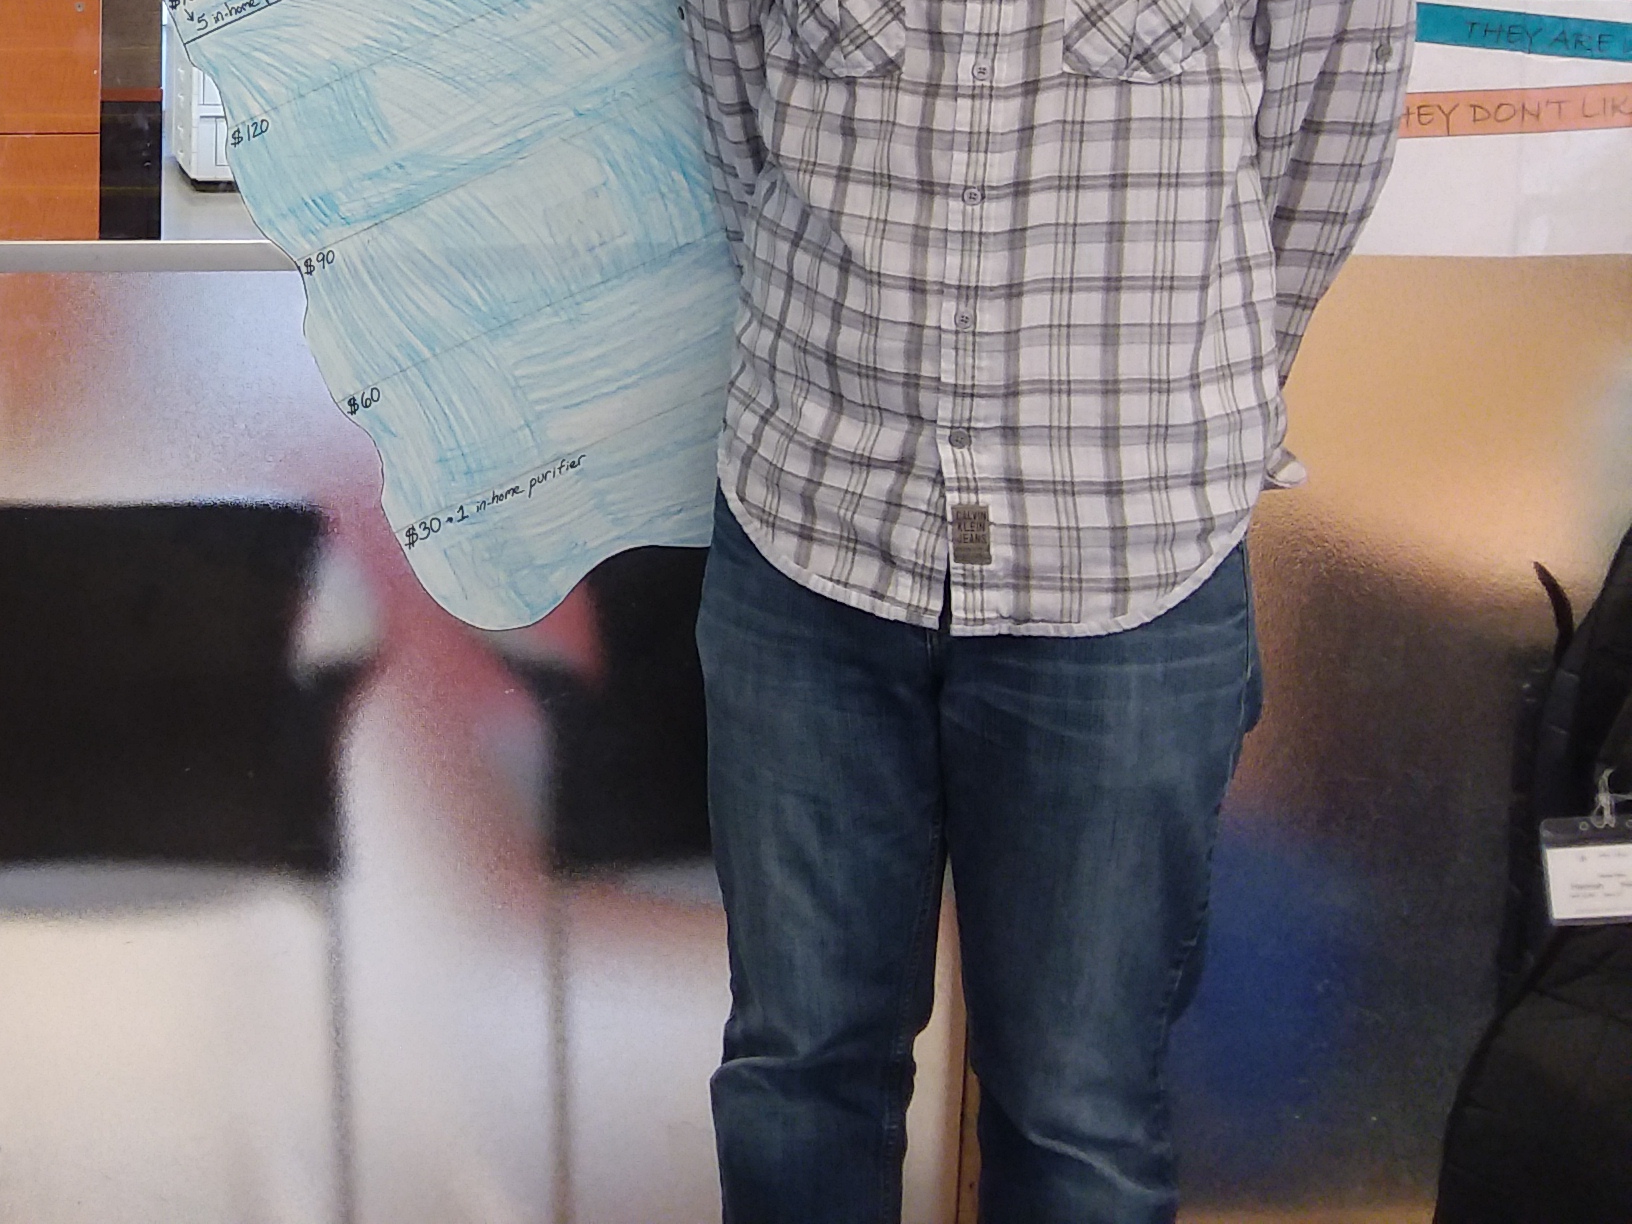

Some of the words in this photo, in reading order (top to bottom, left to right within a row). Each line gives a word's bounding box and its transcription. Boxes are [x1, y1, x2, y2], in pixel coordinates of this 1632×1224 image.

[197, 13, 208, 31] 5
[212, 2, 260, 24] in-home
[1467, 22, 1543, 54] THEY
[1549, 30, 1615, 53] ARE
[1400, 103, 1459, 136] HEY
[1470, 99, 1568, 123] DON'T
[231, 119, 269, 148] $120
[303, 250, 335, 275] $90
[347, 387, 381, 415] $60
[404, 517, 441, 549] $30
[457, 505, 468, 523] 1
[476, 484, 523, 514] in-home
[528, 454, 586, 498] purifier
[955, 510, 987, 521] CALVIN
[958, 521, 986, 532] KLEIN
[958, 533, 987, 544] JEANS
